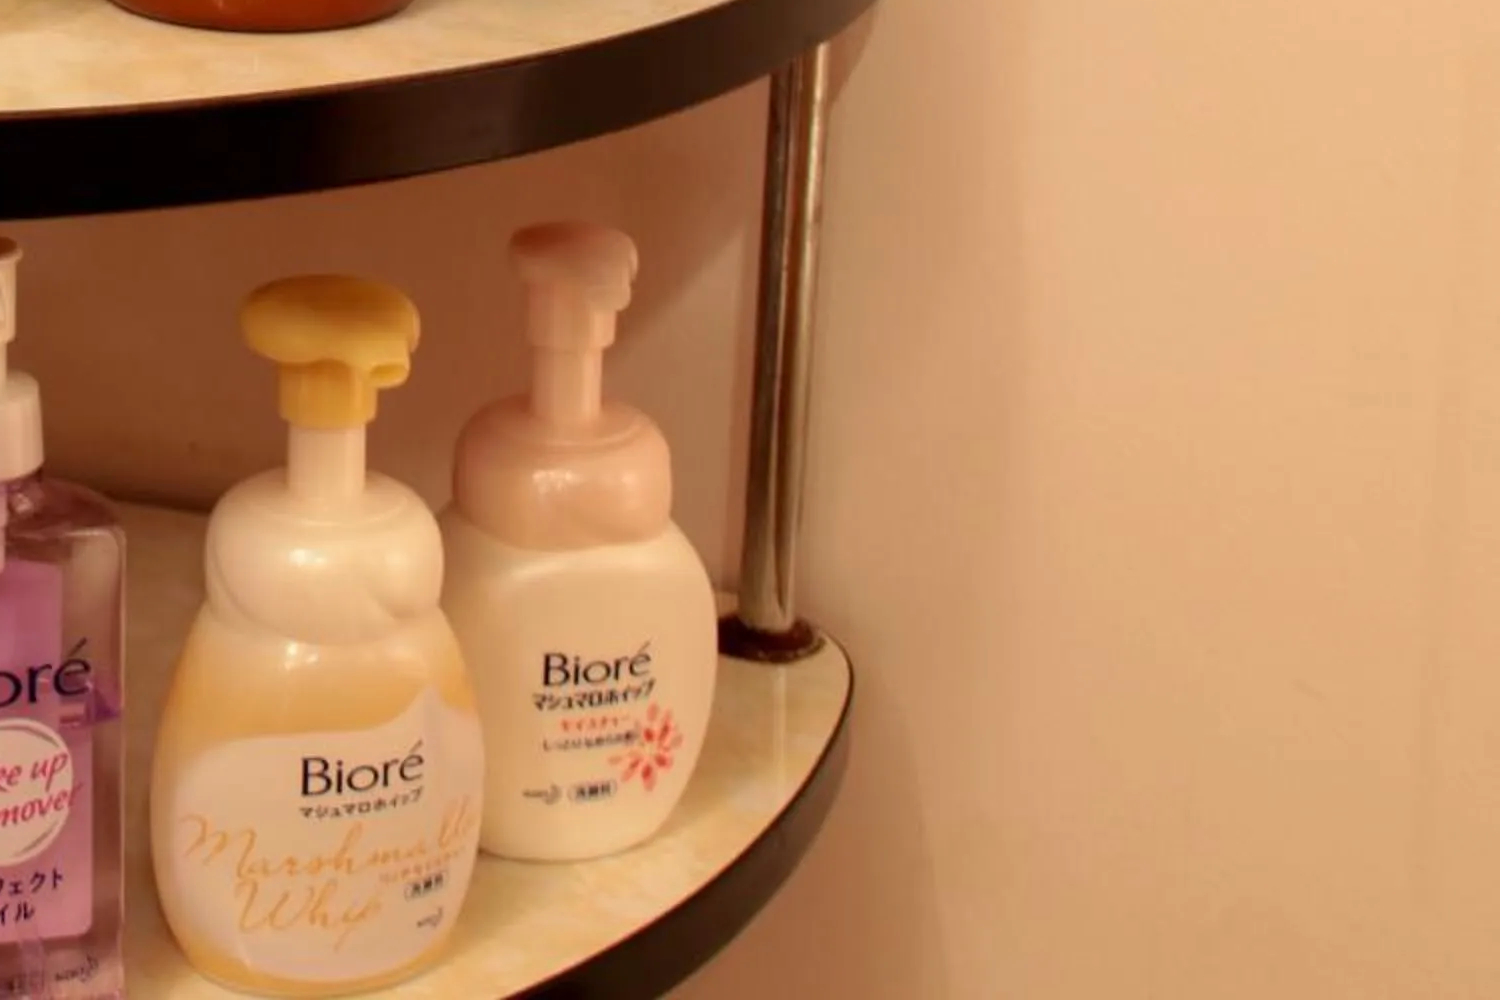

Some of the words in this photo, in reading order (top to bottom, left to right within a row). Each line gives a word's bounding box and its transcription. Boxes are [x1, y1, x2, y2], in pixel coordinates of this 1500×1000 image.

[543, 640, 652, 688] Bioré
[30, 752, 70, 793] up
[300, 740, 426, 798] Bioré
[298, 786, 424, 820] マシュマロホイップ
